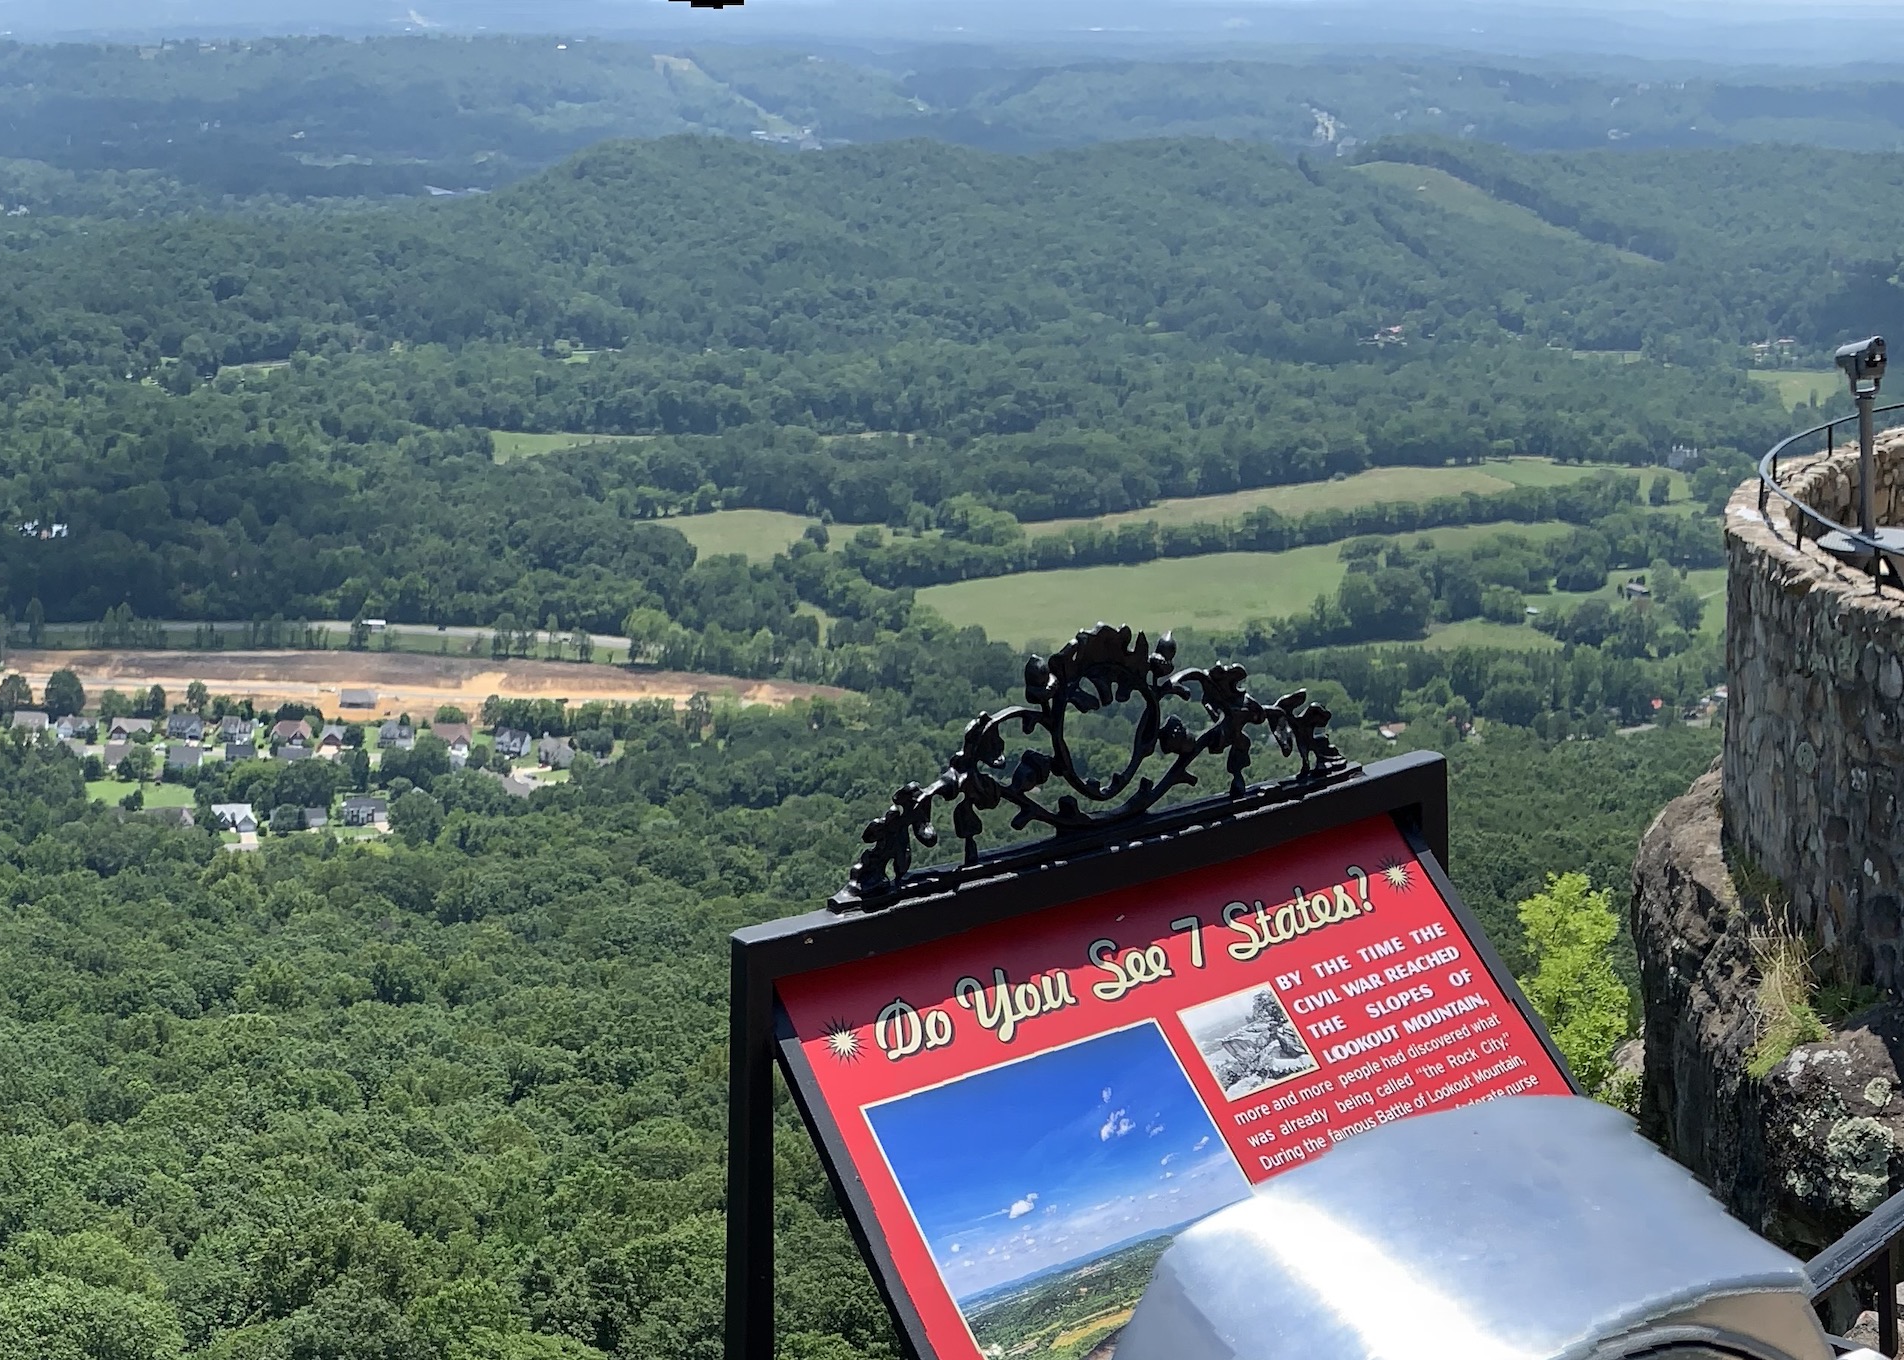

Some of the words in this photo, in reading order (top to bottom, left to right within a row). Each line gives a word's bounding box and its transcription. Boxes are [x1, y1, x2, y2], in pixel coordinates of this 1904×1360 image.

[874, 997, 955, 1062] Do
[955, 968, 1078, 1043] You
[1087, 939, 1174, 1001] See
[1171, 917, 1205, 969] 7
[1222, 865, 1376, 961] States?
[1275, 970, 1303, 992] BY
[1311, 955, 1352, 979] THE
[1356, 936, 1406, 963] TIME
[1408, 922, 1448, 945] THE
[1293, 988, 1343, 1015] CIVIL
[1340, 973, 1386, 998] WAR
[1383, 945, 1461, 983] REACHED
[1306, 1015, 1348, 1040] THE
[1365, 983, 1434, 1019] SLOPES
[1448, 968, 1473, 988] OF
[1322, 1024, 1400, 1065] LOOKOUT
[1401, 992, 1490, 1035] MOUNTAIN,
[1234, 1104, 1272, 1126] more
[1272, 1092, 1299, 1112] and
[1299, 1079, 1335, 1102] more
[1338, 1061, 1382, 1088] people
[1380, 1050, 1407, 1069] had
[1407, 1023, 1472, 1059] discovered
[1470, 1012, 1502, 1034] what
[1247, 1128, 1276, 1149] was
[1278, 1107, 1330, 1137] already
[1334, 1090, 1375, 1115] being
[1376, 1072, 1415, 1098] called
[1446, 1047, 1480, 1069] Rock
[1504, 1074, 1540, 1096] nurse
[1259, 1144, 1306, 1171] During
[1303, 1135, 1327, 1154] the
[1327, 1116, 1378, 1144] famous
[1374, 1101, 1414, 1126] Battle
[1413, 1093, 1428, 1109] of
[1425, 1074, 1476, 1104] Lookout
[1471, 1054, 1528, 1085] Mountain,
